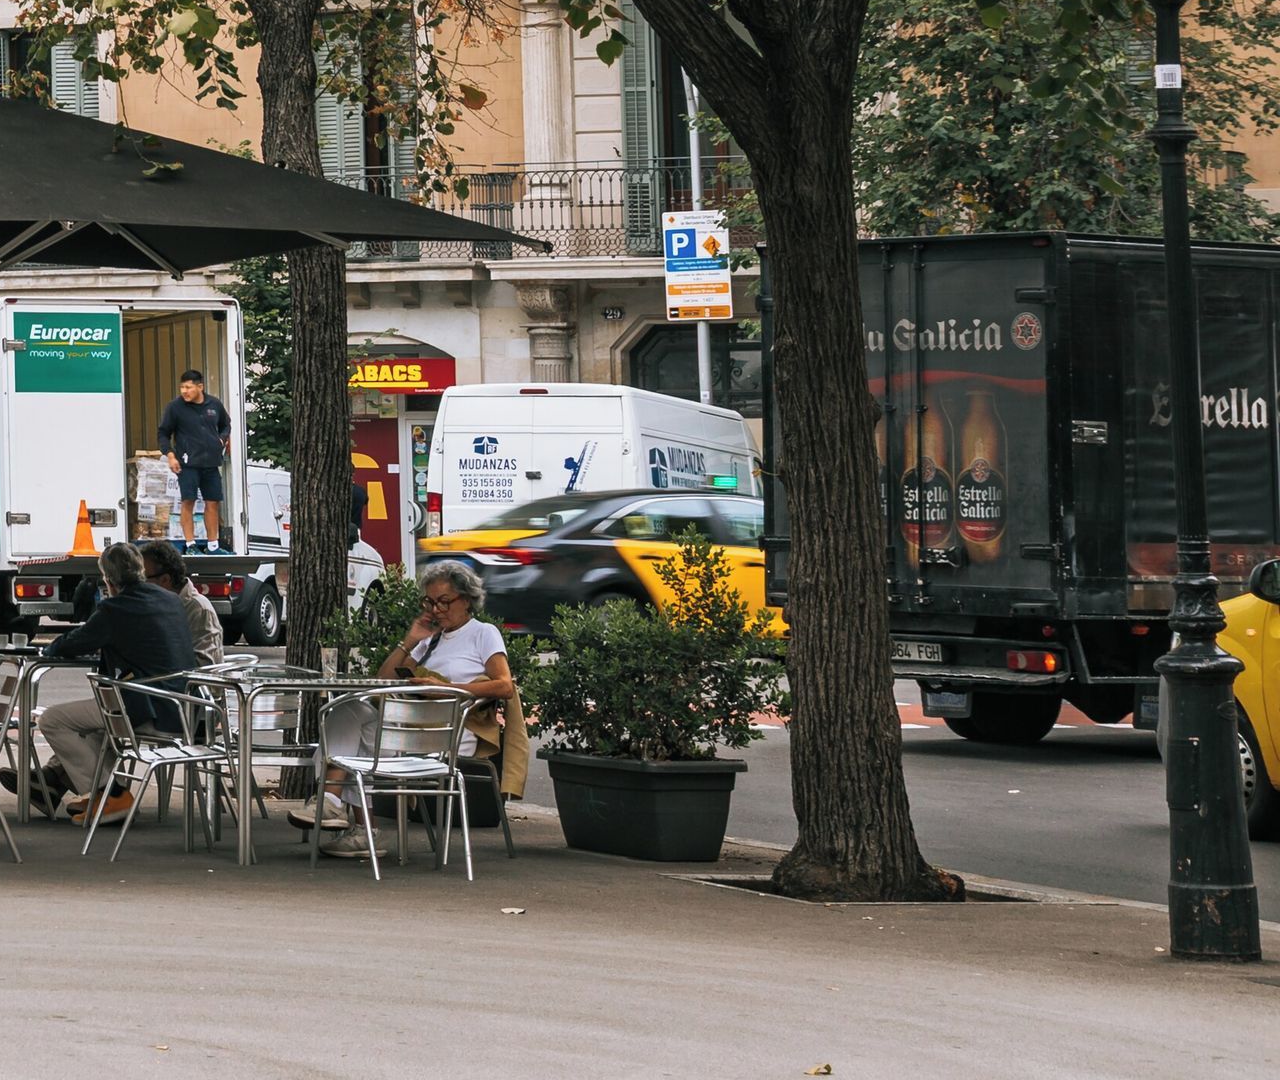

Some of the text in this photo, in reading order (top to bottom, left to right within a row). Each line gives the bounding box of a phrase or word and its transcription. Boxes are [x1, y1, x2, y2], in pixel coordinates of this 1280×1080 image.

[672, 233, 689, 256] P
[605, 309, 621, 319] 29
[29, 324, 112, 345] Europcar
[893, 319, 1003, 351] Galicia
[29, 350, 112, 360] moving your way
[349, 364, 422, 381] ABACS
[1150, 383, 1269, 429] Erella
[488, 445, 497, 454] RF
[459, 459, 517, 470] MUDANZAS
[667, 446, 706, 477] MUDANZAS
[462, 478, 513, 487] 935 155 809
[496, 489, 513, 498] 350
[959, 485, 1002, 501] Estrella
[960, 502, 1001, 518] Galicia
[917, 643, 940, 660] FGH
